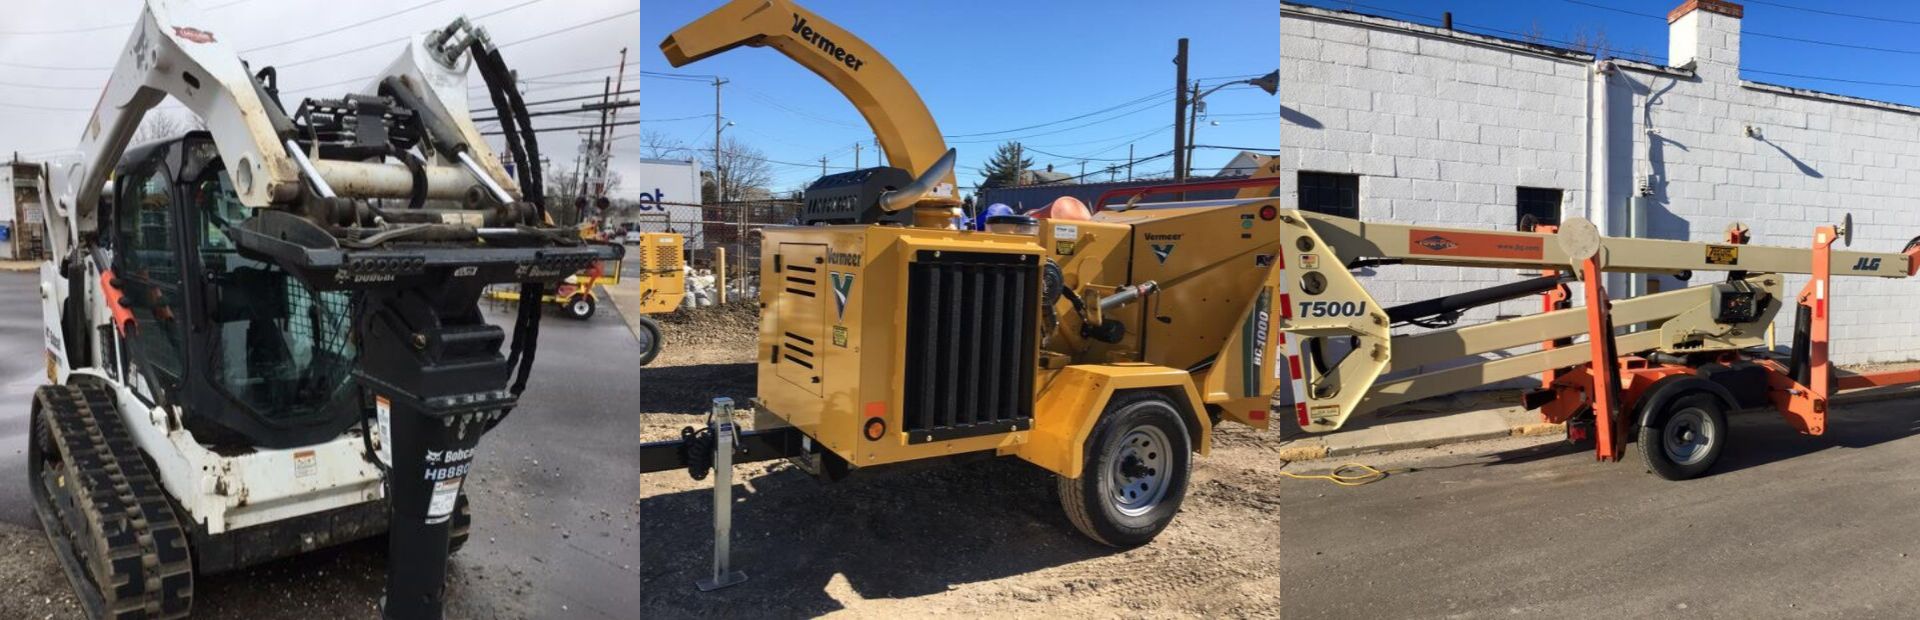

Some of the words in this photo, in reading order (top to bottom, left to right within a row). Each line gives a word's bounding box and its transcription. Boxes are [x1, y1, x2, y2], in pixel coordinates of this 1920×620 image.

[792, 12, 863, 71] Vermeer
[827, 248, 861, 267] Vermeer
[1853, 257, 1881, 271] JLG
[1299, 301, 1366, 318] T500J
